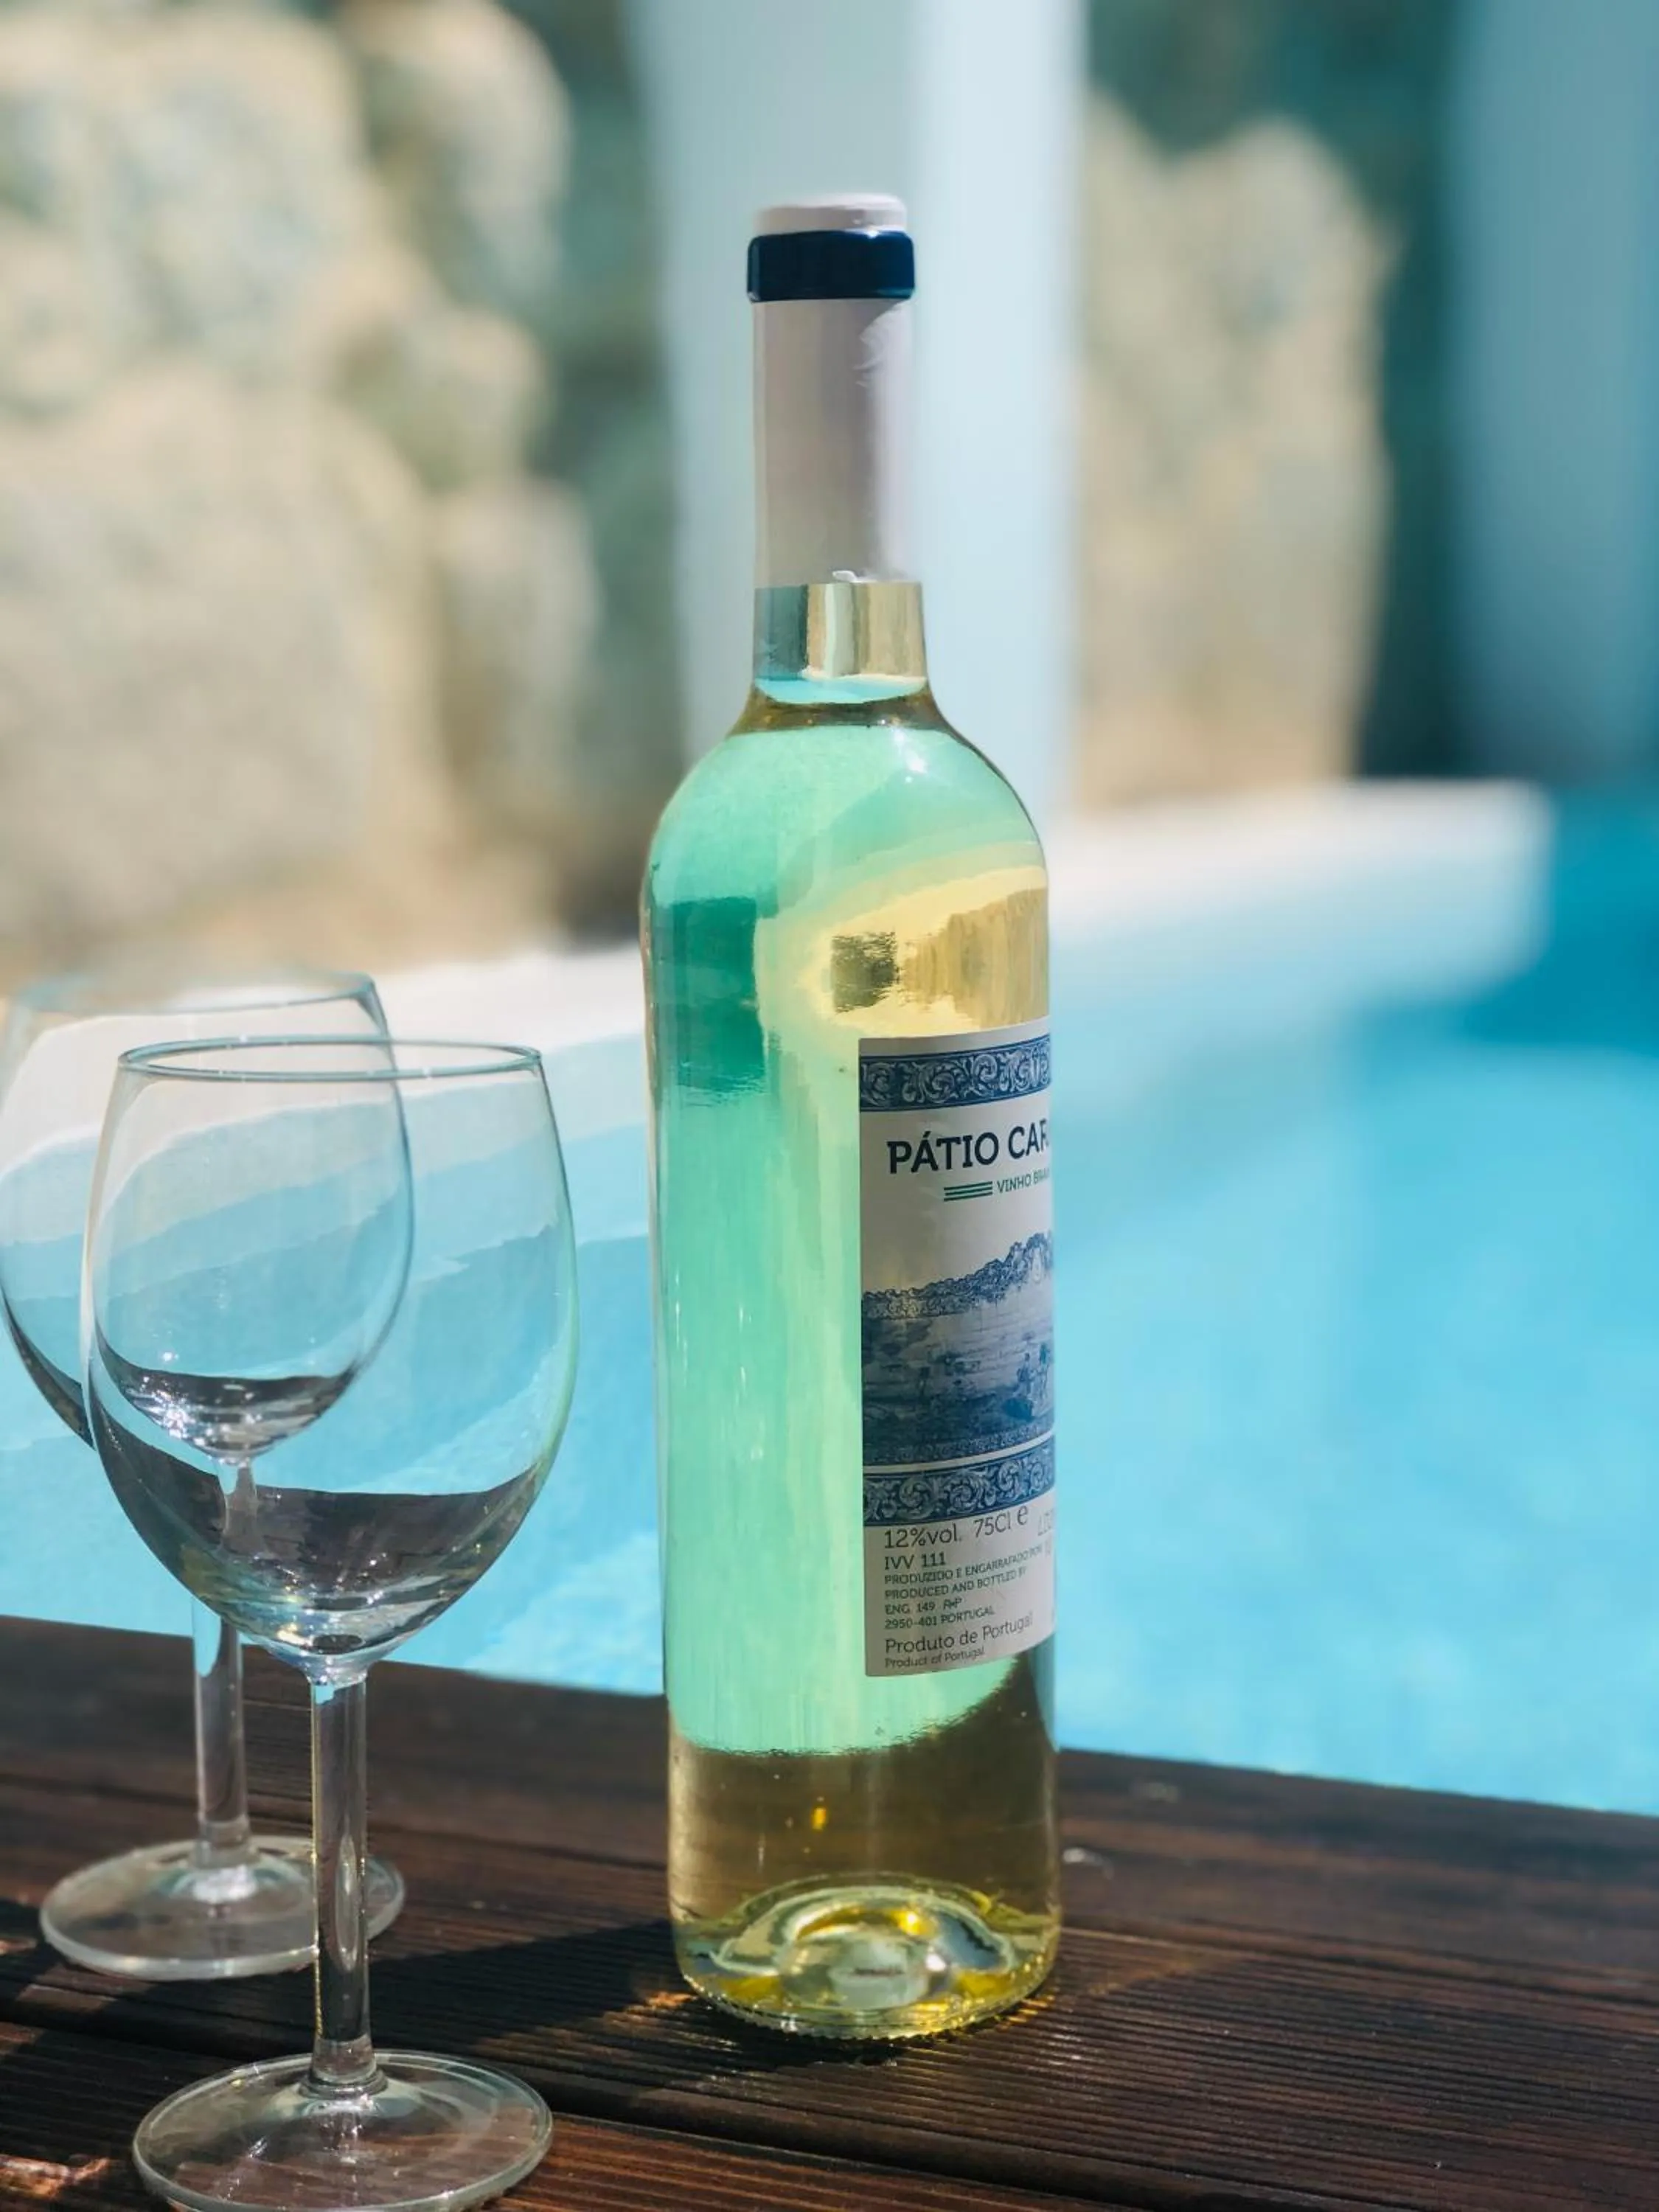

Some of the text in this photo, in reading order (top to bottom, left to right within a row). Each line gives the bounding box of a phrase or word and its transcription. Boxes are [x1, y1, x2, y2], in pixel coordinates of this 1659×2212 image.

[887, 1131, 999, 1174] PÁTIO
[997, 1172, 1032, 1194] VINHO
[885, 1551, 946, 1570] IVV 111
[885, 1570, 953, 1585] PRODUZIDO
[885, 1585, 949, 1599] PRODUCED
[952, 1579, 975, 1594] AND
[940, 1605, 996, 1625] PORTUGAL
[885, 1610, 1033, 1654] Produto de Portugal
[885, 1646, 986, 1669] Product of Portugal
